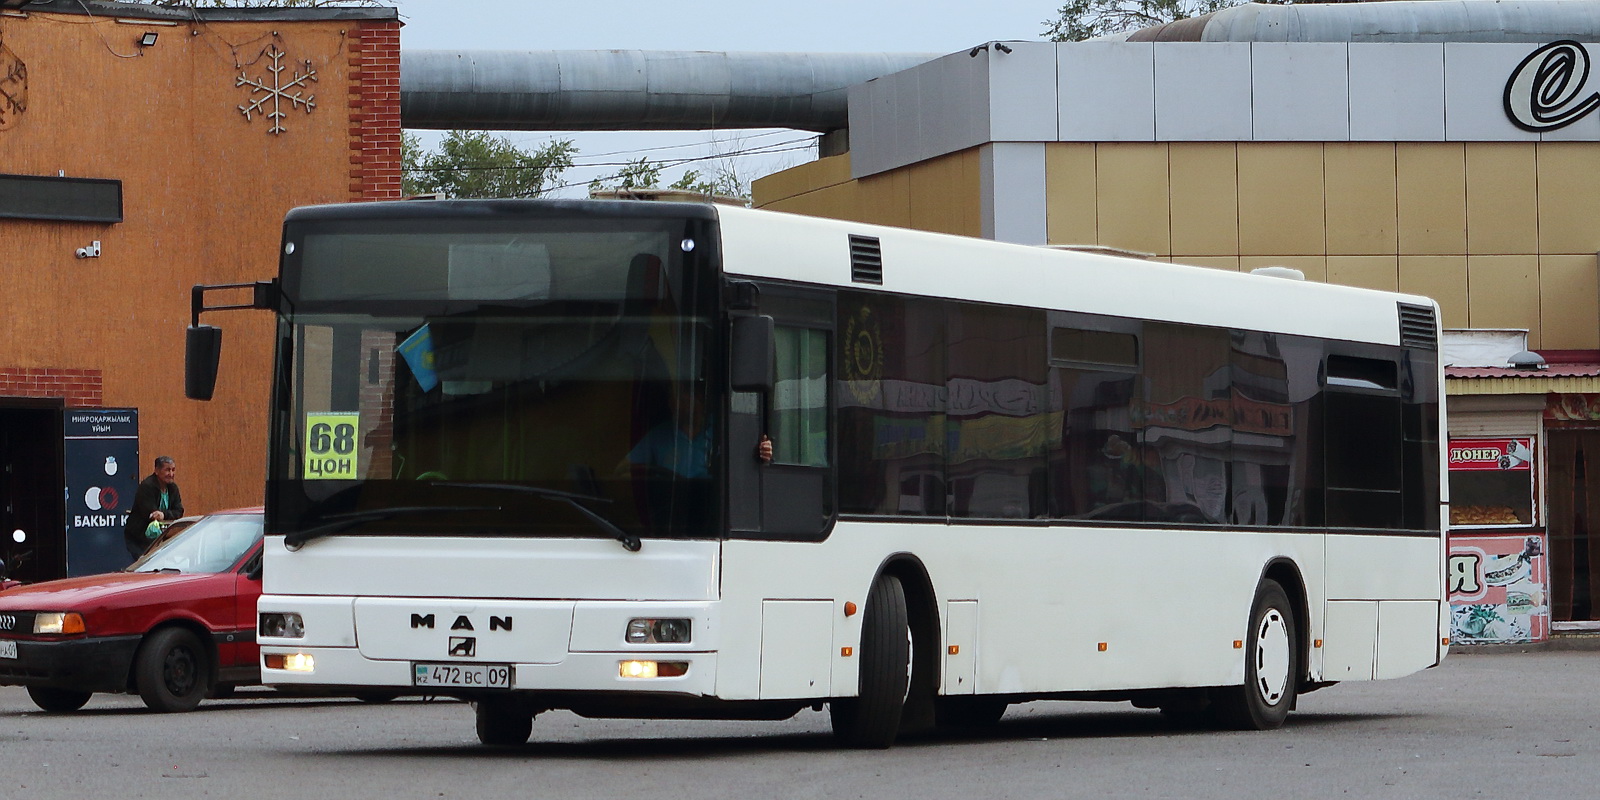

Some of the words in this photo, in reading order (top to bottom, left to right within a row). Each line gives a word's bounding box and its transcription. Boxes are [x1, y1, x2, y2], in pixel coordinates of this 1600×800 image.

[310, 423, 354, 455] 68
[1451, 449, 1500, 461] ДОНЕР
[310, 459, 351, 477] ЦОН
[74, 515, 117, 528] БАКЫТ
[410, 613, 513, 631] MAN
[416, 676, 428, 684] KZ
[432, 667, 460, 684] 472
[488, 668, 508, 686] 09
